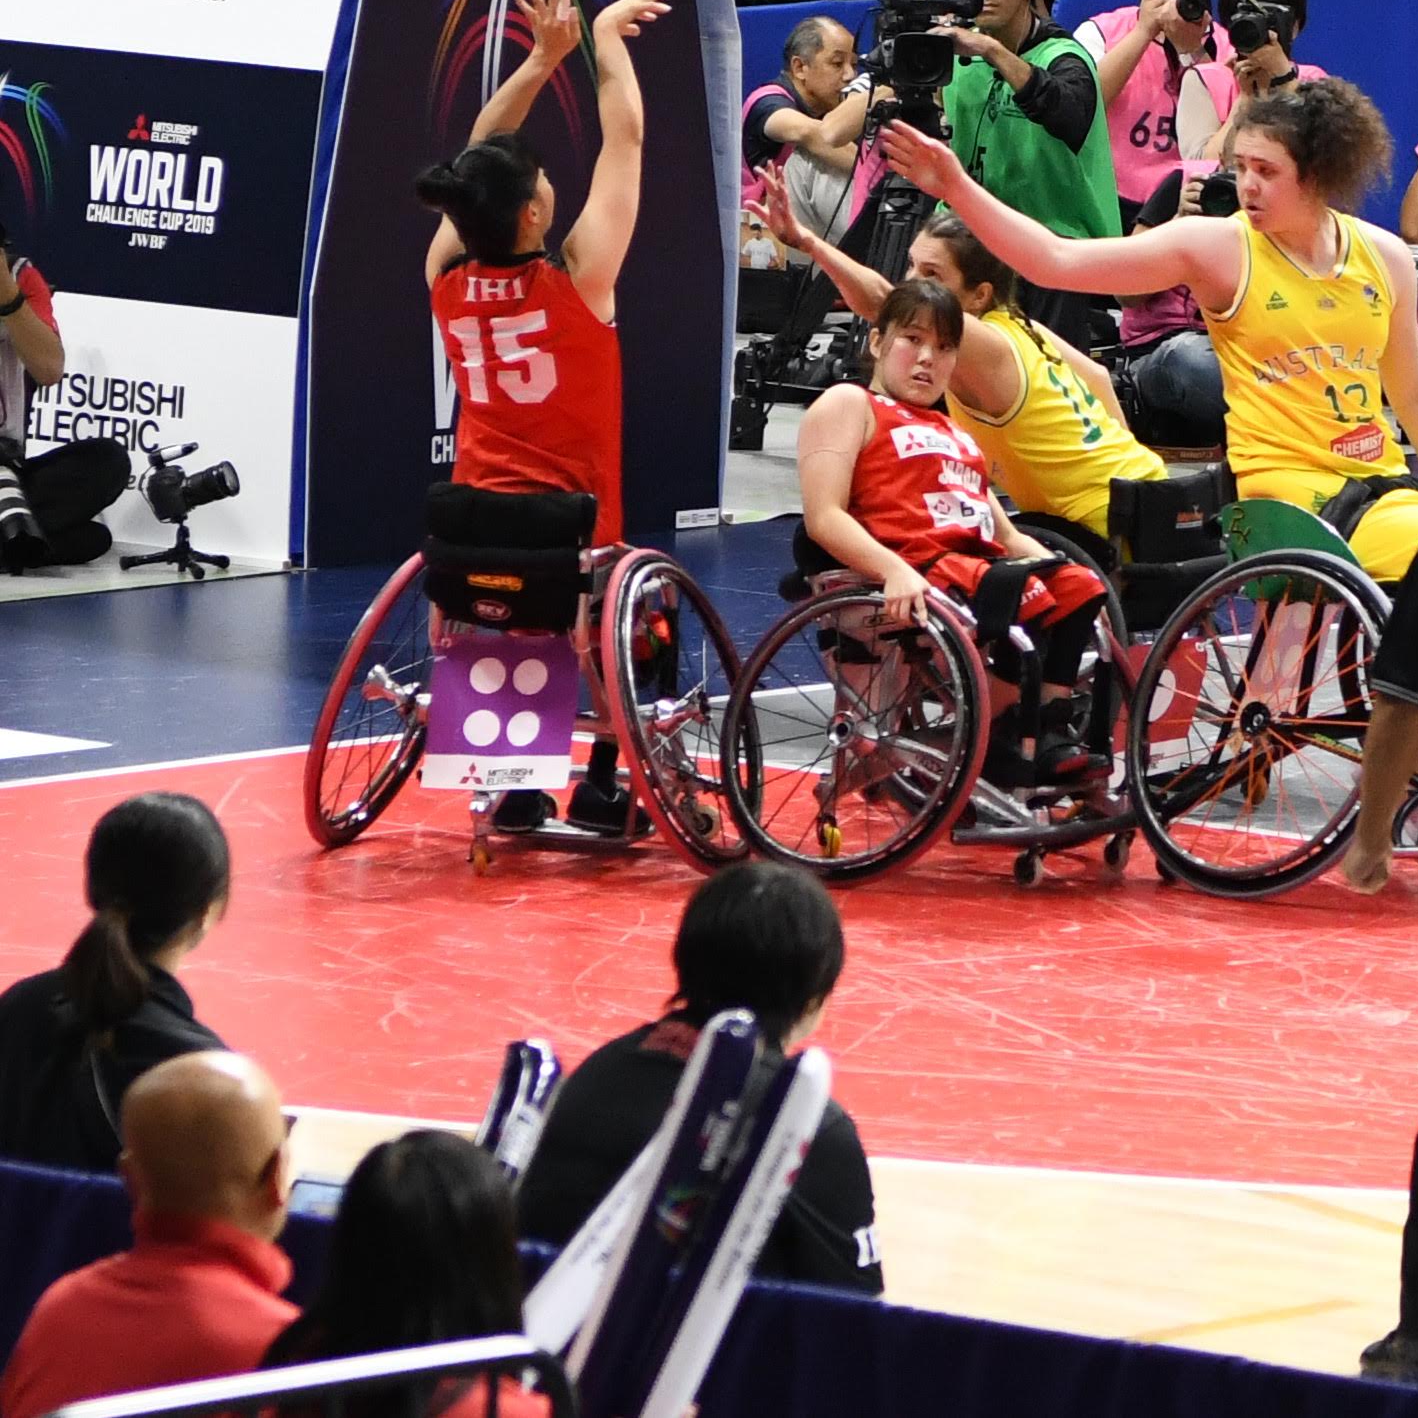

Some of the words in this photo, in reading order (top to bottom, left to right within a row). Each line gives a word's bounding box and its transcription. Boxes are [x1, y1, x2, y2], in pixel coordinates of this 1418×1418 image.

[150, 132, 191, 145] ELECTRIC
[151, 121, 199, 136] MITSUBISHI
[1130, 110, 1175, 153] 65
[90, 144, 223, 213] WORLD
[86, 203, 158, 229] CHALLENGE
[158, 210, 184, 231] CUP
[183, 213, 216, 235] 2019
[127, 232, 168, 250] JWBF
[465, 276, 526, 303] IHI
[448, 309, 559, 405] 15
[1332, 433, 1385, 457] CHEMIST
